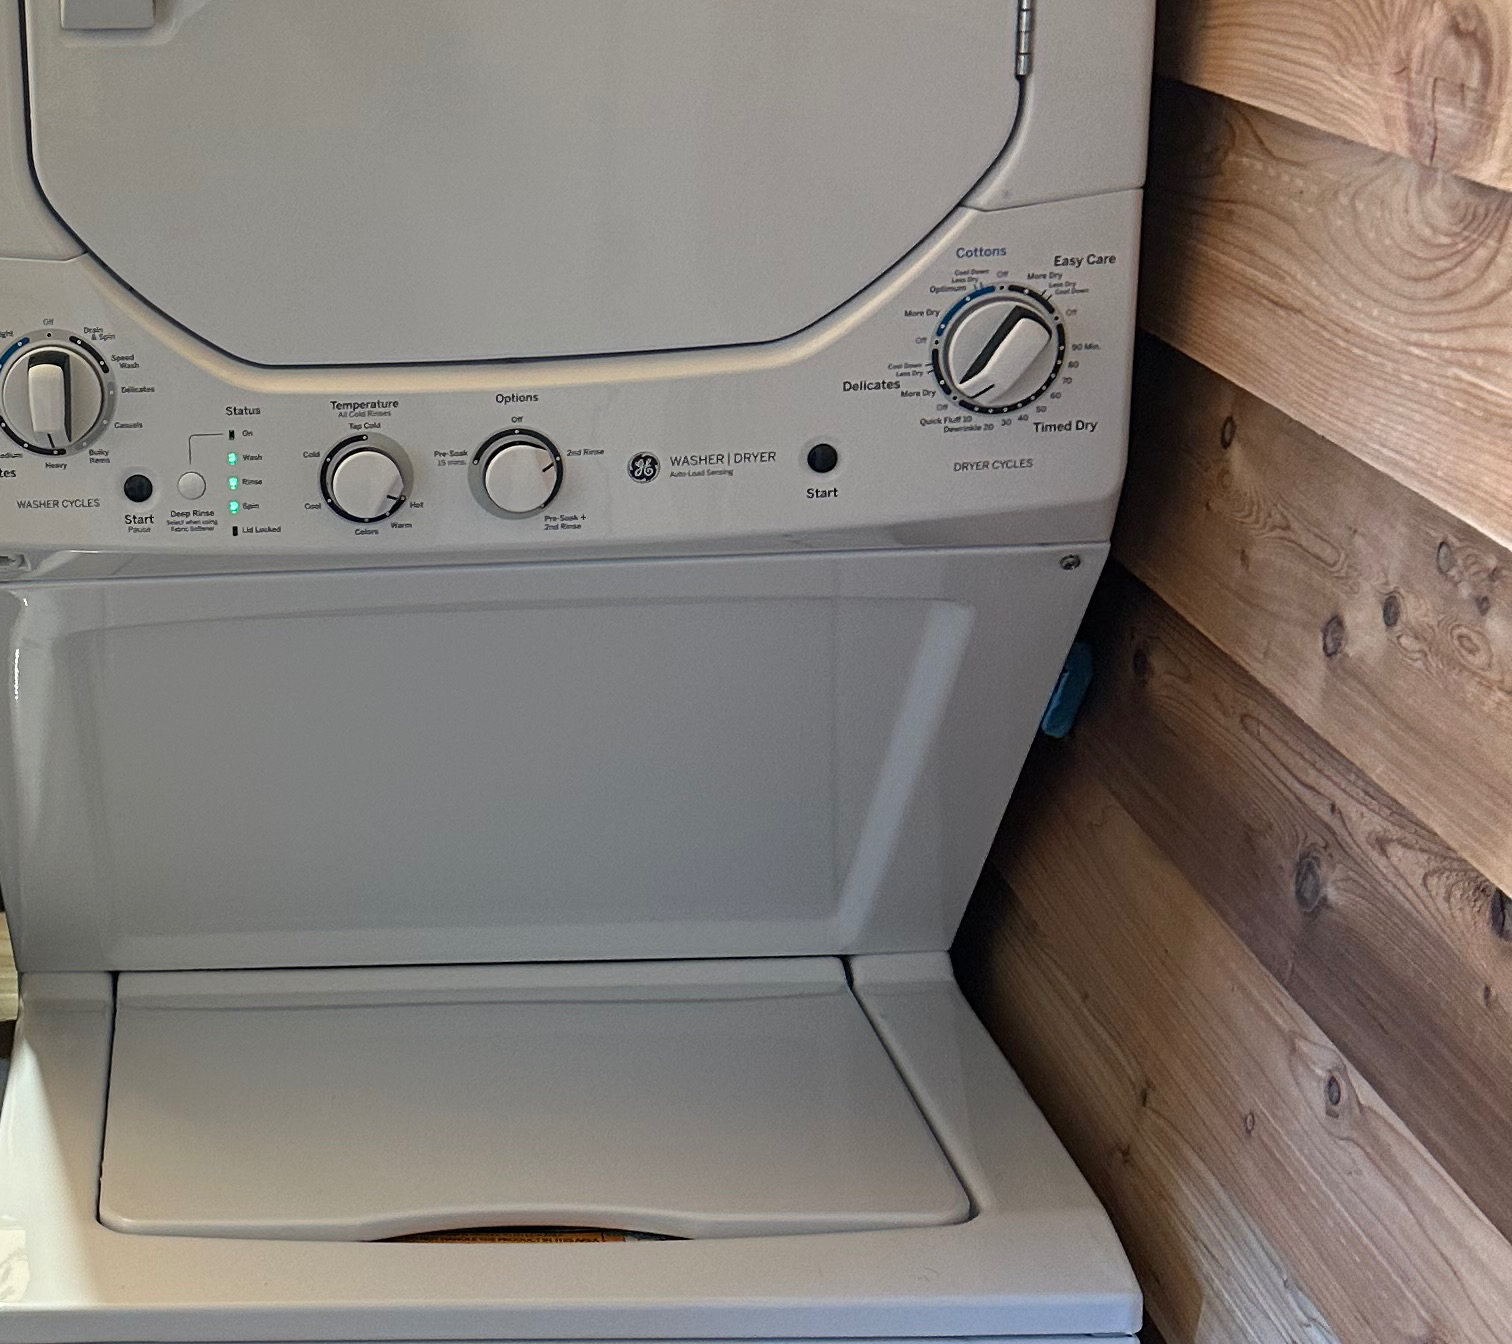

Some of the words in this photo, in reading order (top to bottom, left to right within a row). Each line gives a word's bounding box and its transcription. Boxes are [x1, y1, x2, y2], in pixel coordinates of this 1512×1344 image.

[956, 246, 1007, 258] Cottons
[1054, 255, 1084, 268] Easy
[1087, 254, 1116, 265] Care
[967, 276, 978, 284] Dry
[1048, 271, 1063, 280] Dry
[904, 309, 924, 317] More
[925, 308, 940, 317] Dry
[1062, 376, 1072, 384] 70
[842, 379, 900, 392] Delicates
[922, 389, 936, 398] Dry
[1050, 391, 1062, 399] 60
[495, 393, 539, 405] Options
[330, 399, 399, 411] Temperature
[225, 406, 261, 416] Status
[919, 418, 942, 426] Quick
[1033, 421, 1072, 433] Timed
[1076, 420, 1099, 433] Dry
[670, 454, 725, 466] WASHER
[734, 452, 776, 463] DRYER
[45, 462, 68, 470] Heavy
[627, 451, 661, 484] GE
[953, 461, 990, 472] DRYER
[992, 459, 1033, 469] CYCLES
[806, 487, 838, 499] Start
[16, 499, 59, 509] WASHER
[61, 498, 100, 508] CYCLES
[304, 502, 322, 510] Cool
[170, 510, 190, 518] Deep
[124, 514, 154, 525] Start
[354, 528, 379, 536] Colors
